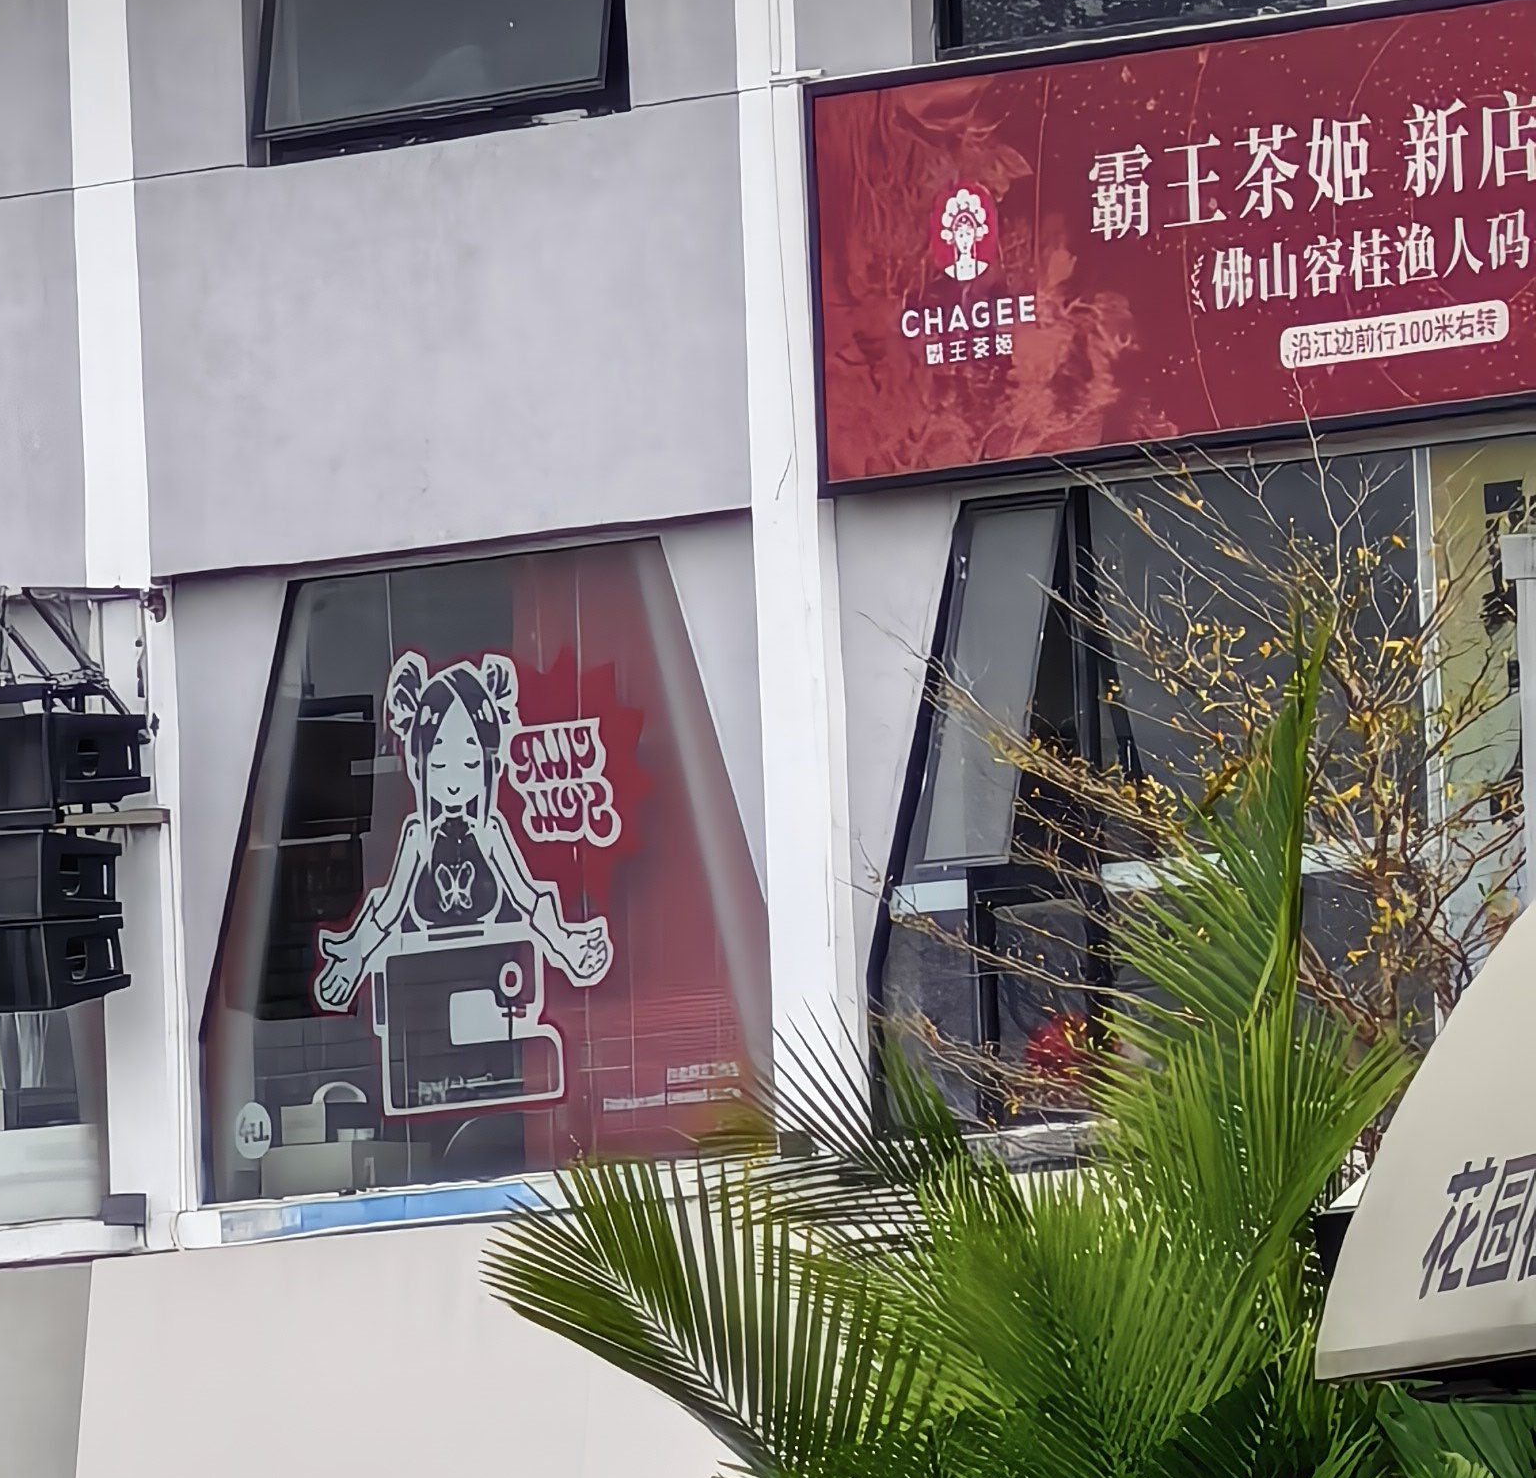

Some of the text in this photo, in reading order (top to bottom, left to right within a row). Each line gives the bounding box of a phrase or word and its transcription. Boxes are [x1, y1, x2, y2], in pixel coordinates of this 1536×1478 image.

[1088, 90, 1536, 241] 霸王茶姬 新店
[1212, 208, 1530, 311] 佛山容桂渔人码
[901, 294, 1037, 338] CHAGEE
[1291, 308, 1498, 363] 沿江边前行100米右转
[1418, 1152, 1536, 1301] 花园
